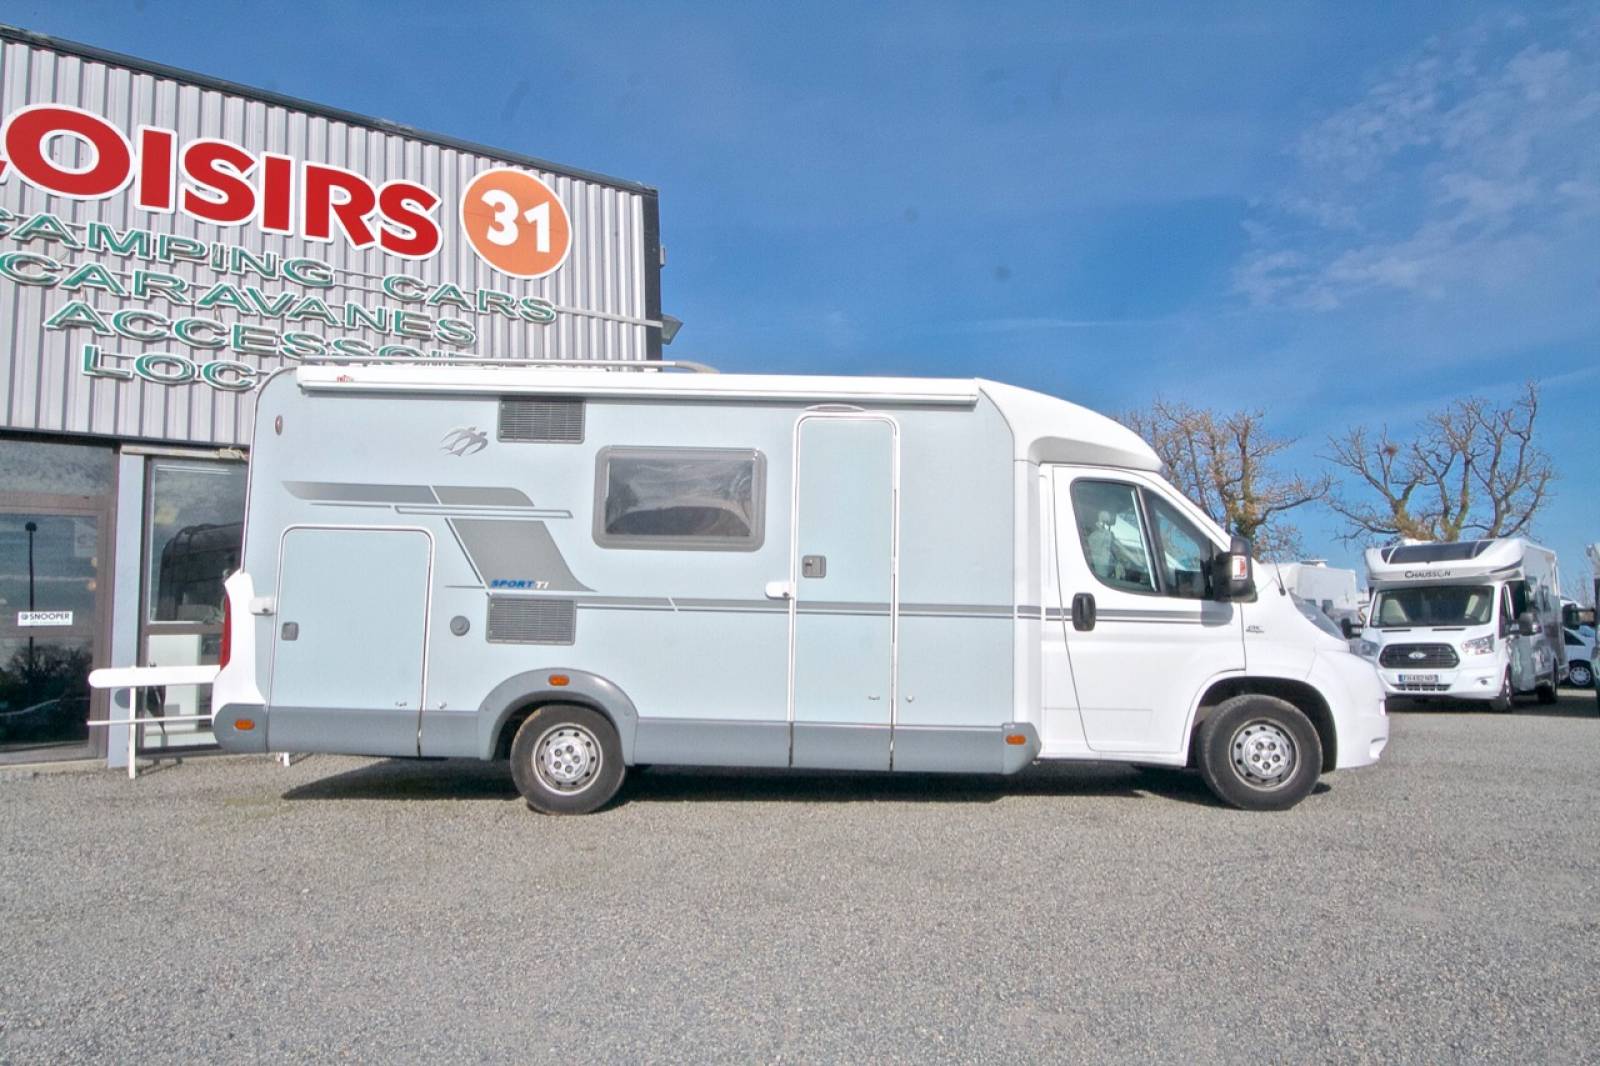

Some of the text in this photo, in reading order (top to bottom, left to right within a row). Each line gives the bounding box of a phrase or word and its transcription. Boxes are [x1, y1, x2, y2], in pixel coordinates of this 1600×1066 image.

[0, 103, 550, 260] OISIRS 31
[0, 207, 557, 323] AMPING CARS
[0, 251, 477, 346] CARAVANES
[81, 343, 258, 392] LOC
[29, 612, 70, 620] SNOOPER
[491, 579, 535, 588] SPORT
